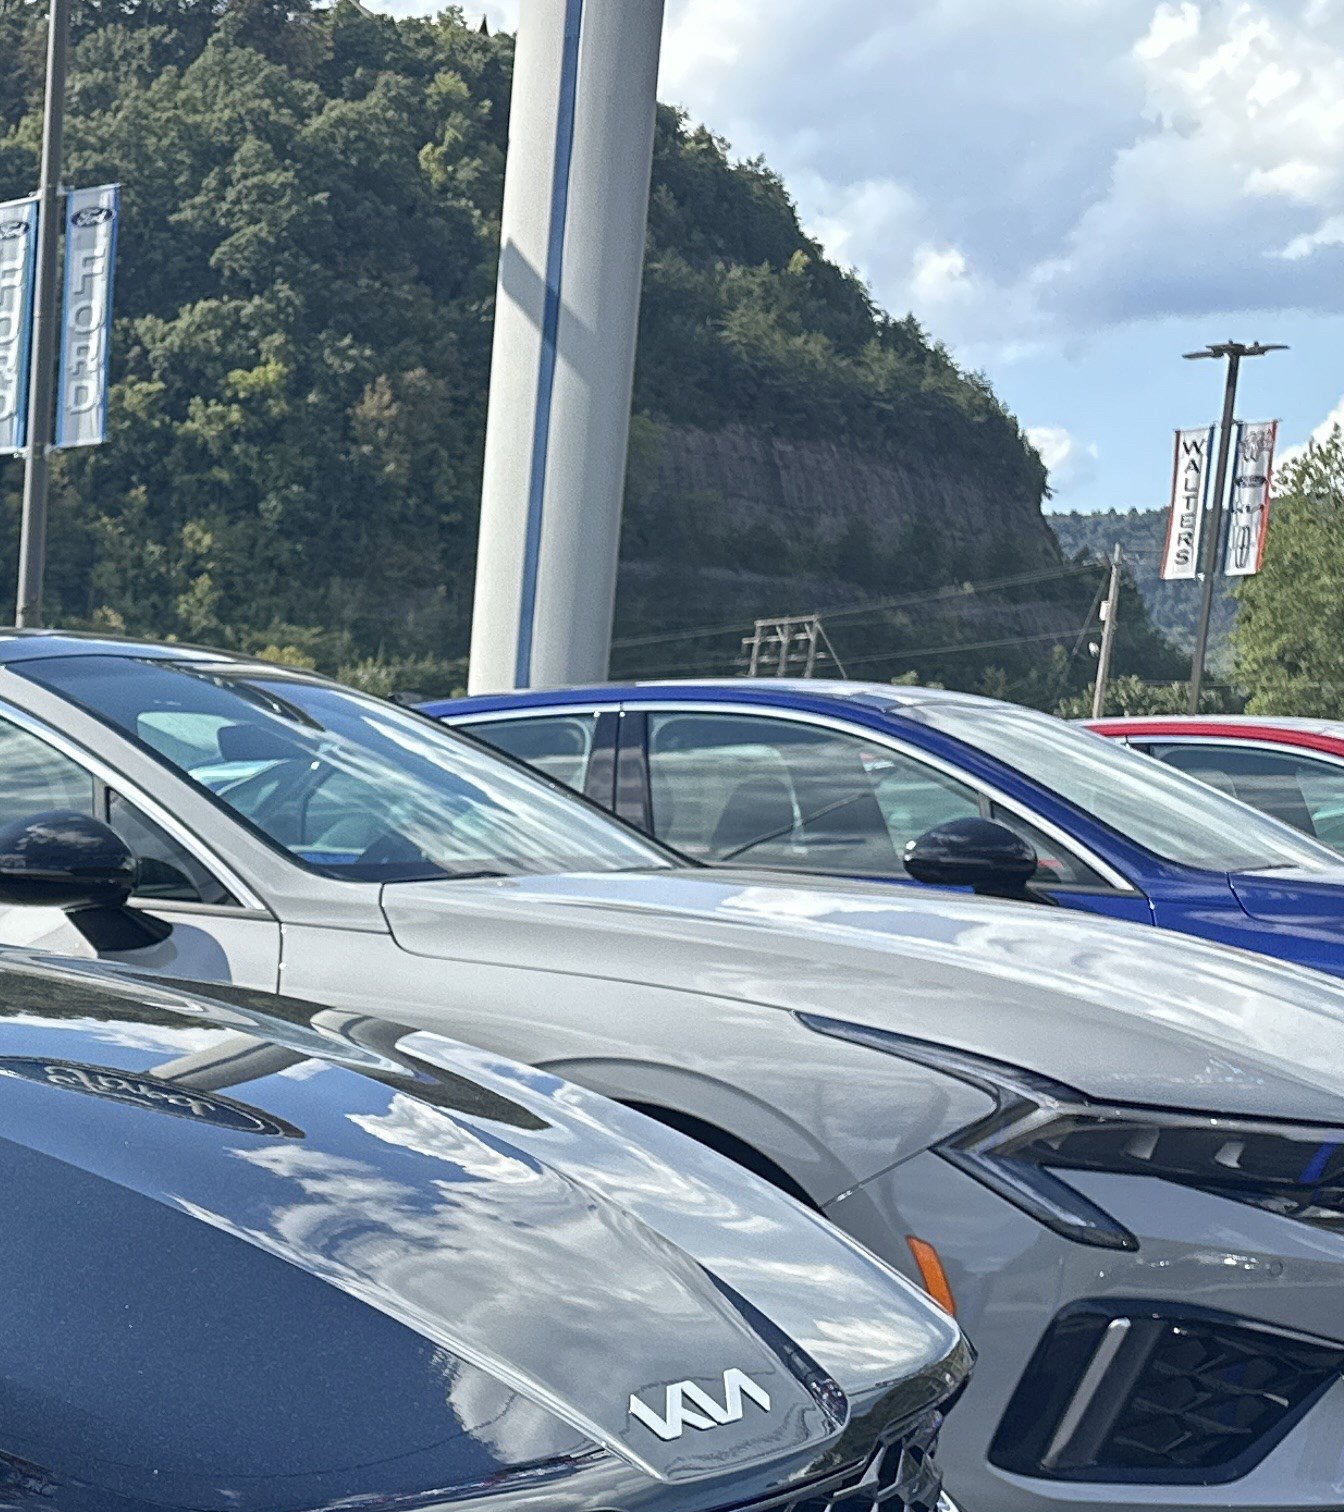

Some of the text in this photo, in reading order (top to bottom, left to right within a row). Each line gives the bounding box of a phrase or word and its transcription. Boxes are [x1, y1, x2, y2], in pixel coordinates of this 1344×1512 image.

[69, 246, 106, 416] FORD
[1174, 438, 1205, 565] WALTERS
[630, 1367, 771, 1441] KIA
